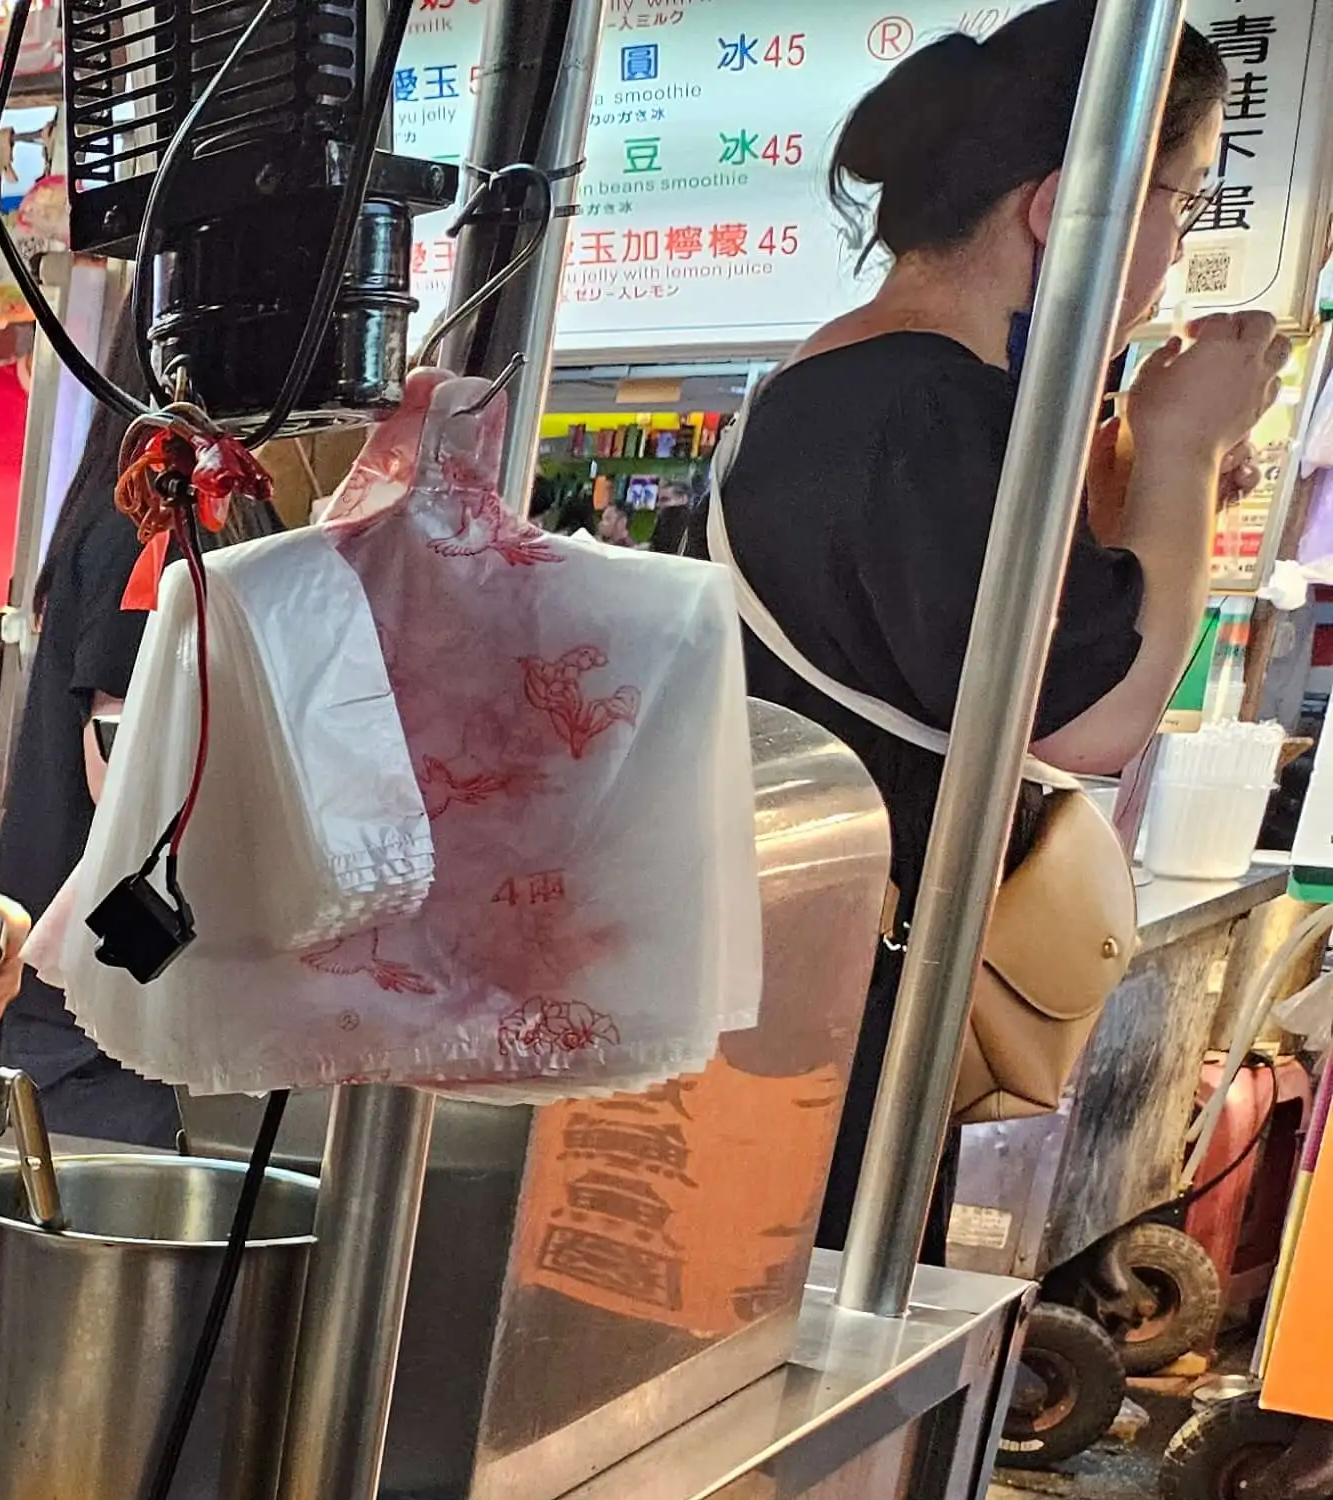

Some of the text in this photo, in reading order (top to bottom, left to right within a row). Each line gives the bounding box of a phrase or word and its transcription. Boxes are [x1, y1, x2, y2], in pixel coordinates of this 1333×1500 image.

[620, 43, 659, 82] 圓
[764, 34, 806, 68] 45
[614, 83, 703, 105] smoothie
[1195, 0, 1277, 233] 青蛙下蛋
[622, 129, 803, 175] 豆 冰 45
[599, 176, 655, 196] beans
[660, 171, 749, 191] smoothie
[757, 225, 799, 256] 45
